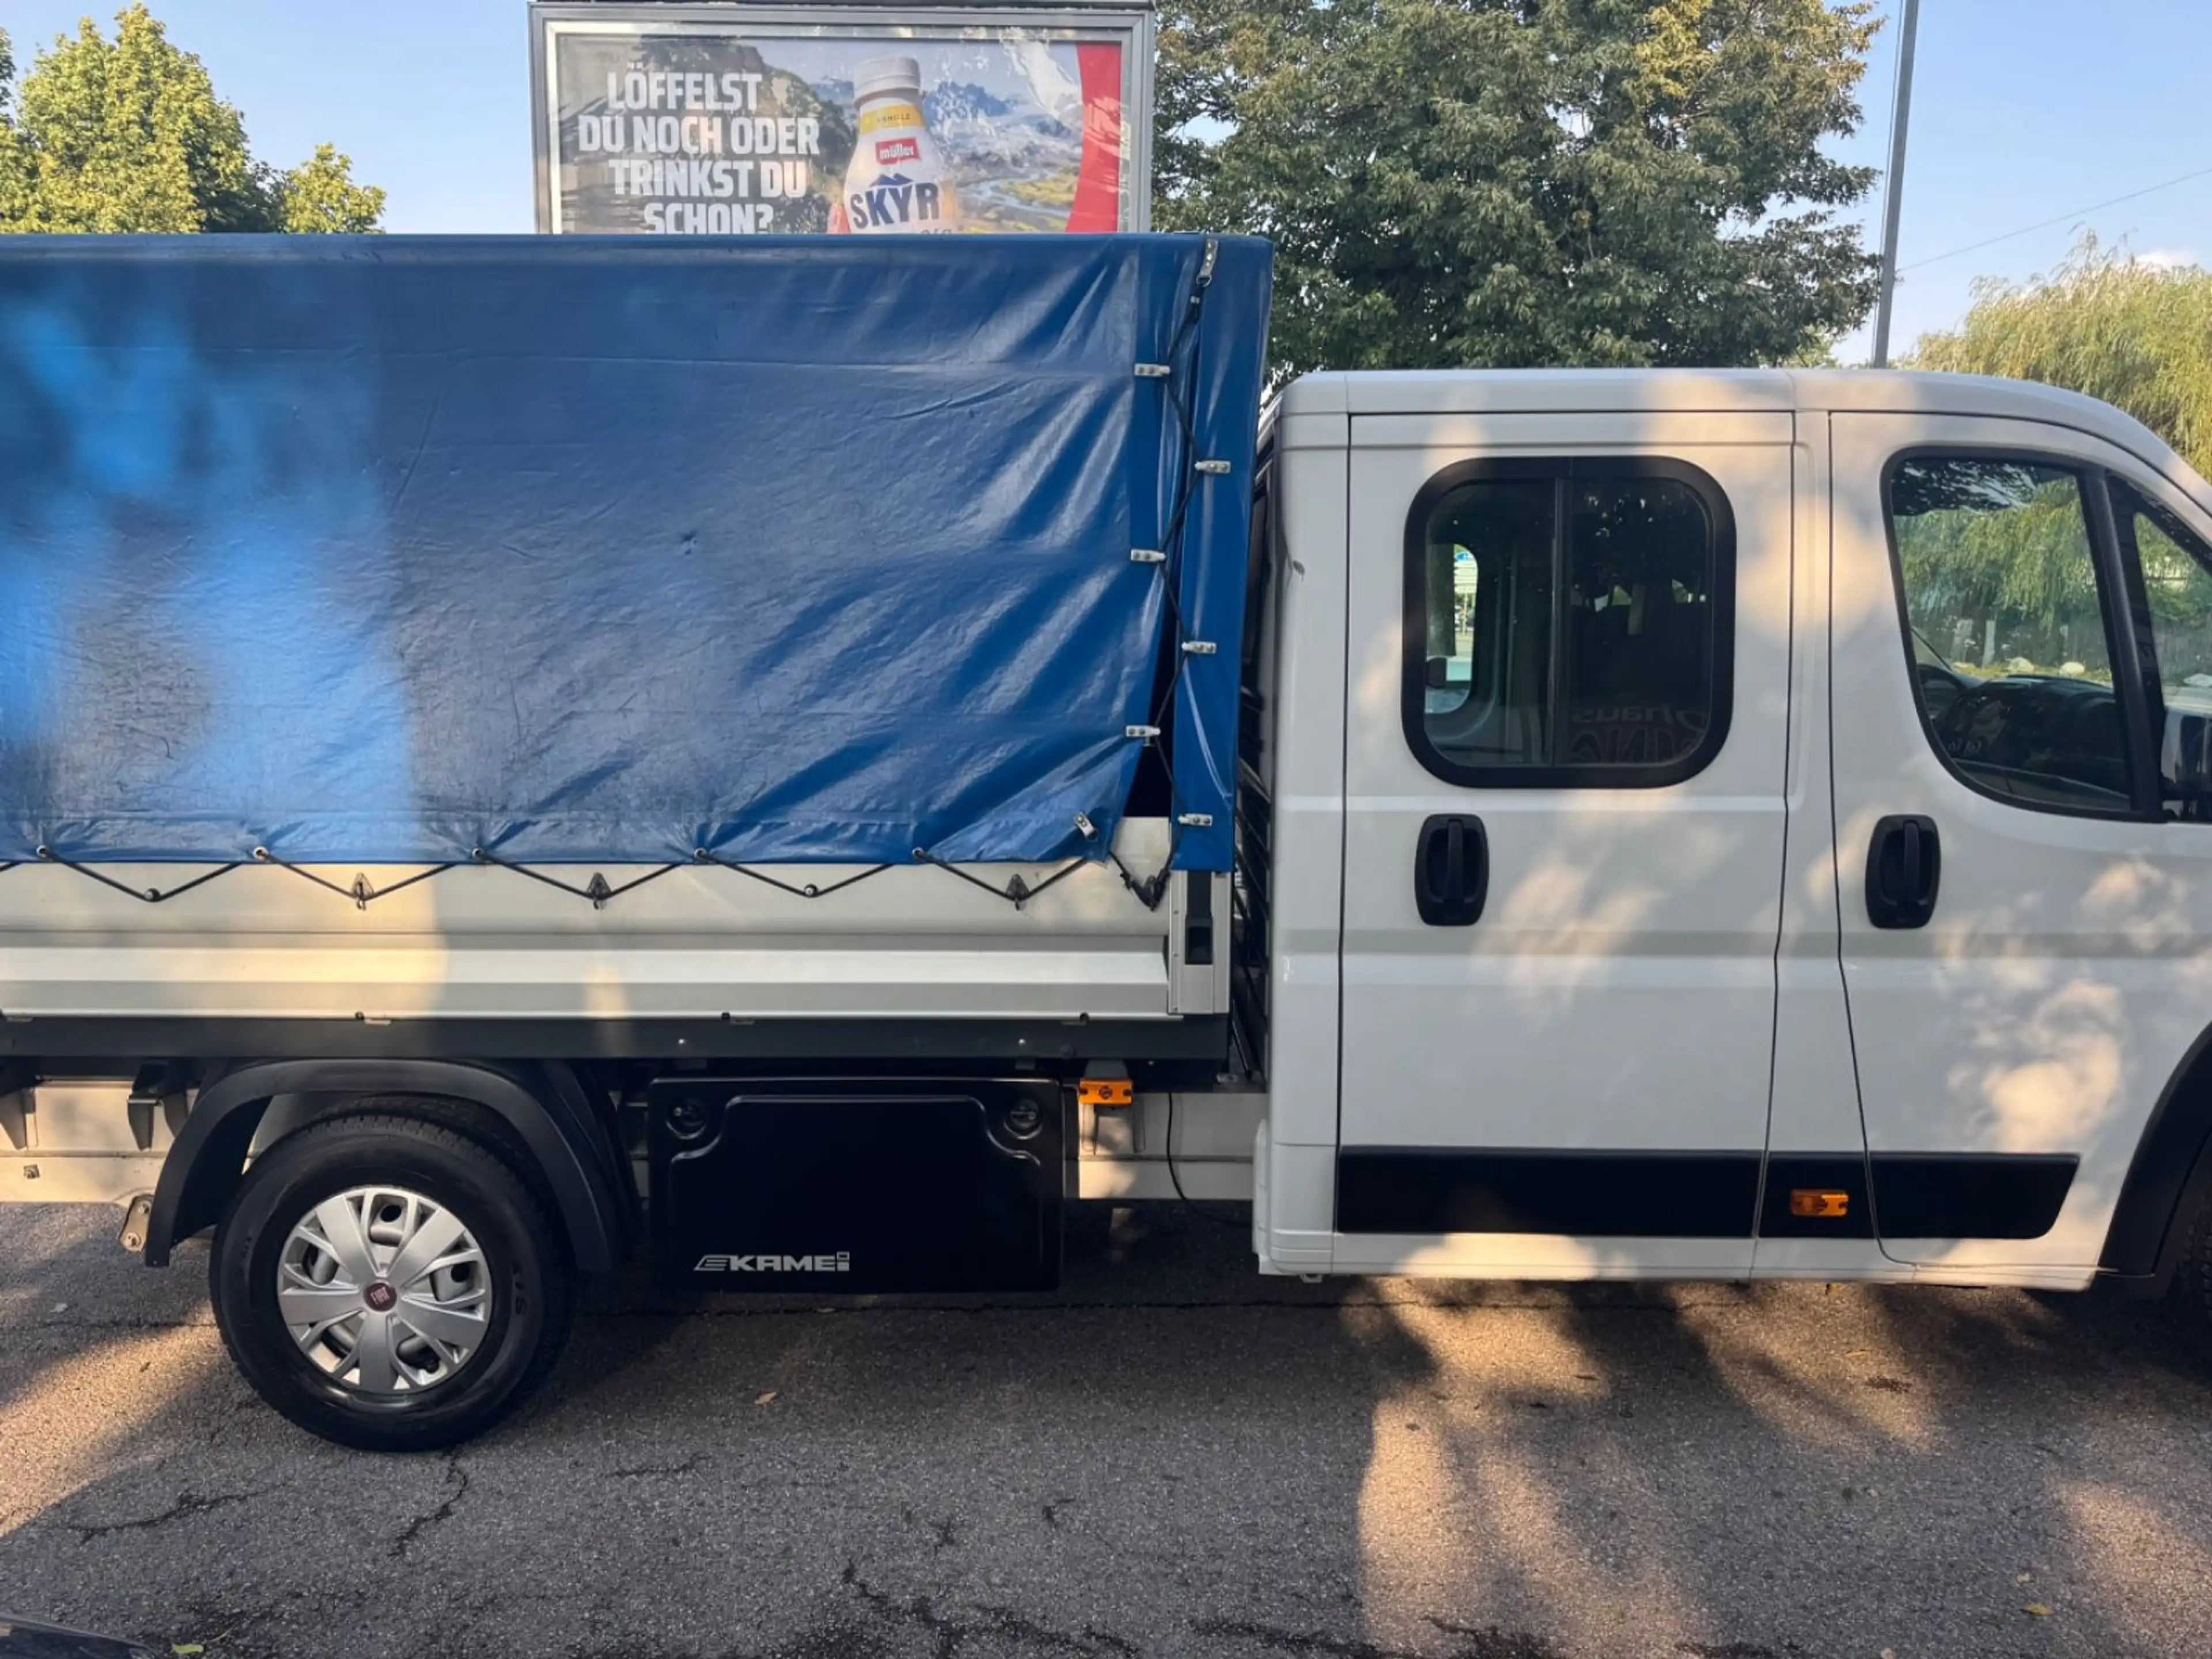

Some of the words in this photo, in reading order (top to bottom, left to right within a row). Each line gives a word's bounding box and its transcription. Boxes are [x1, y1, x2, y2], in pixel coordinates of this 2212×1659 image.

[607, 62, 762, 111] LÖFFELST
[578, 115, 624, 153] DU
[634, 116, 722, 154] NOCH
[731, 118, 820, 155] ODER
[880, 143, 915, 160] müller
[609, 160, 753, 197] TRINKST
[760, 161, 808, 198] DU
[643, 203, 774, 234] SCHON?
[850, 182, 940, 229] SKYR
